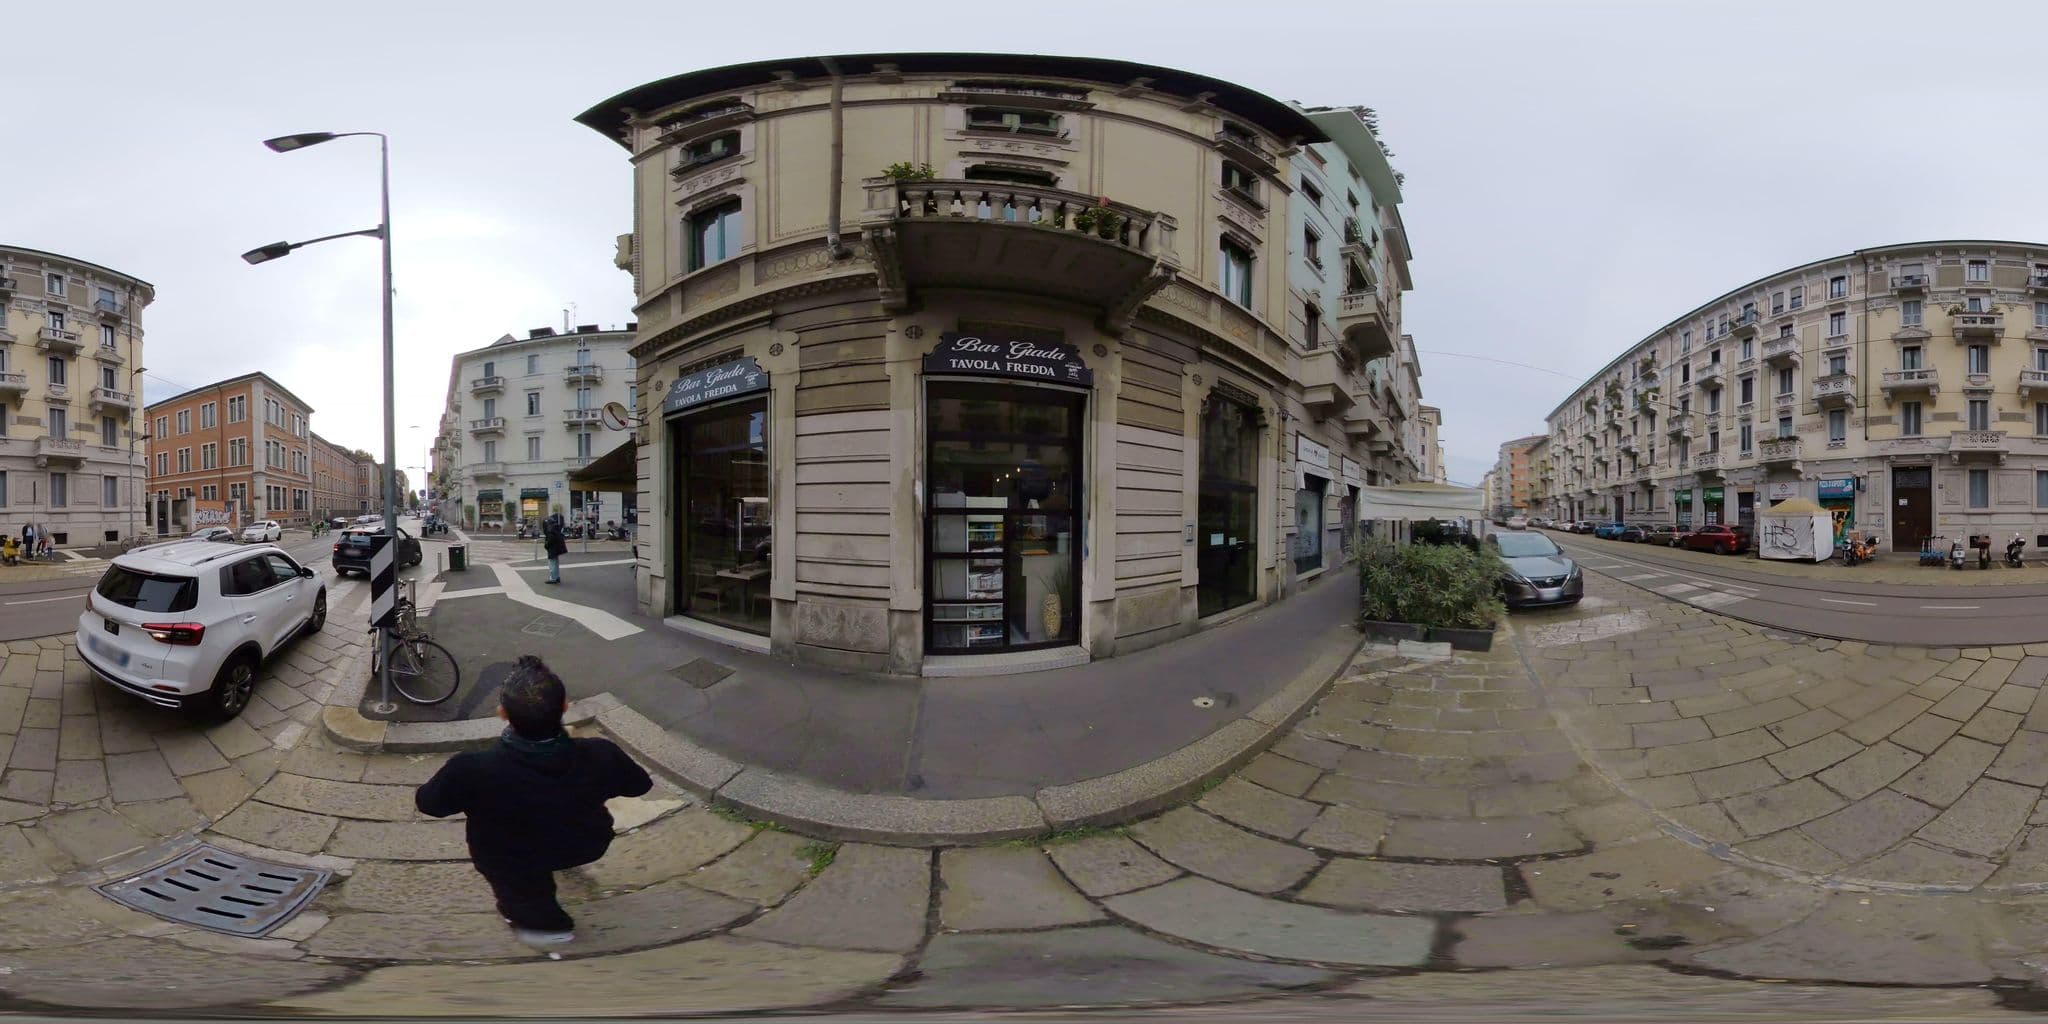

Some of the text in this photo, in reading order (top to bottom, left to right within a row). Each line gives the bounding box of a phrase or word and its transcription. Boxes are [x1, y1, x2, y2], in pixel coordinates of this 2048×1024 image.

[951, 336, 1066, 361] Bar Giada
[675, 378, 701, 393] Bar
[704, 364, 745, 388] Giada
[949, 358, 1001, 371] TAVOLA
[1006, 361, 1056, 377] FREDDA
[675, 383, 738, 407] TAVOLA FREDDA
